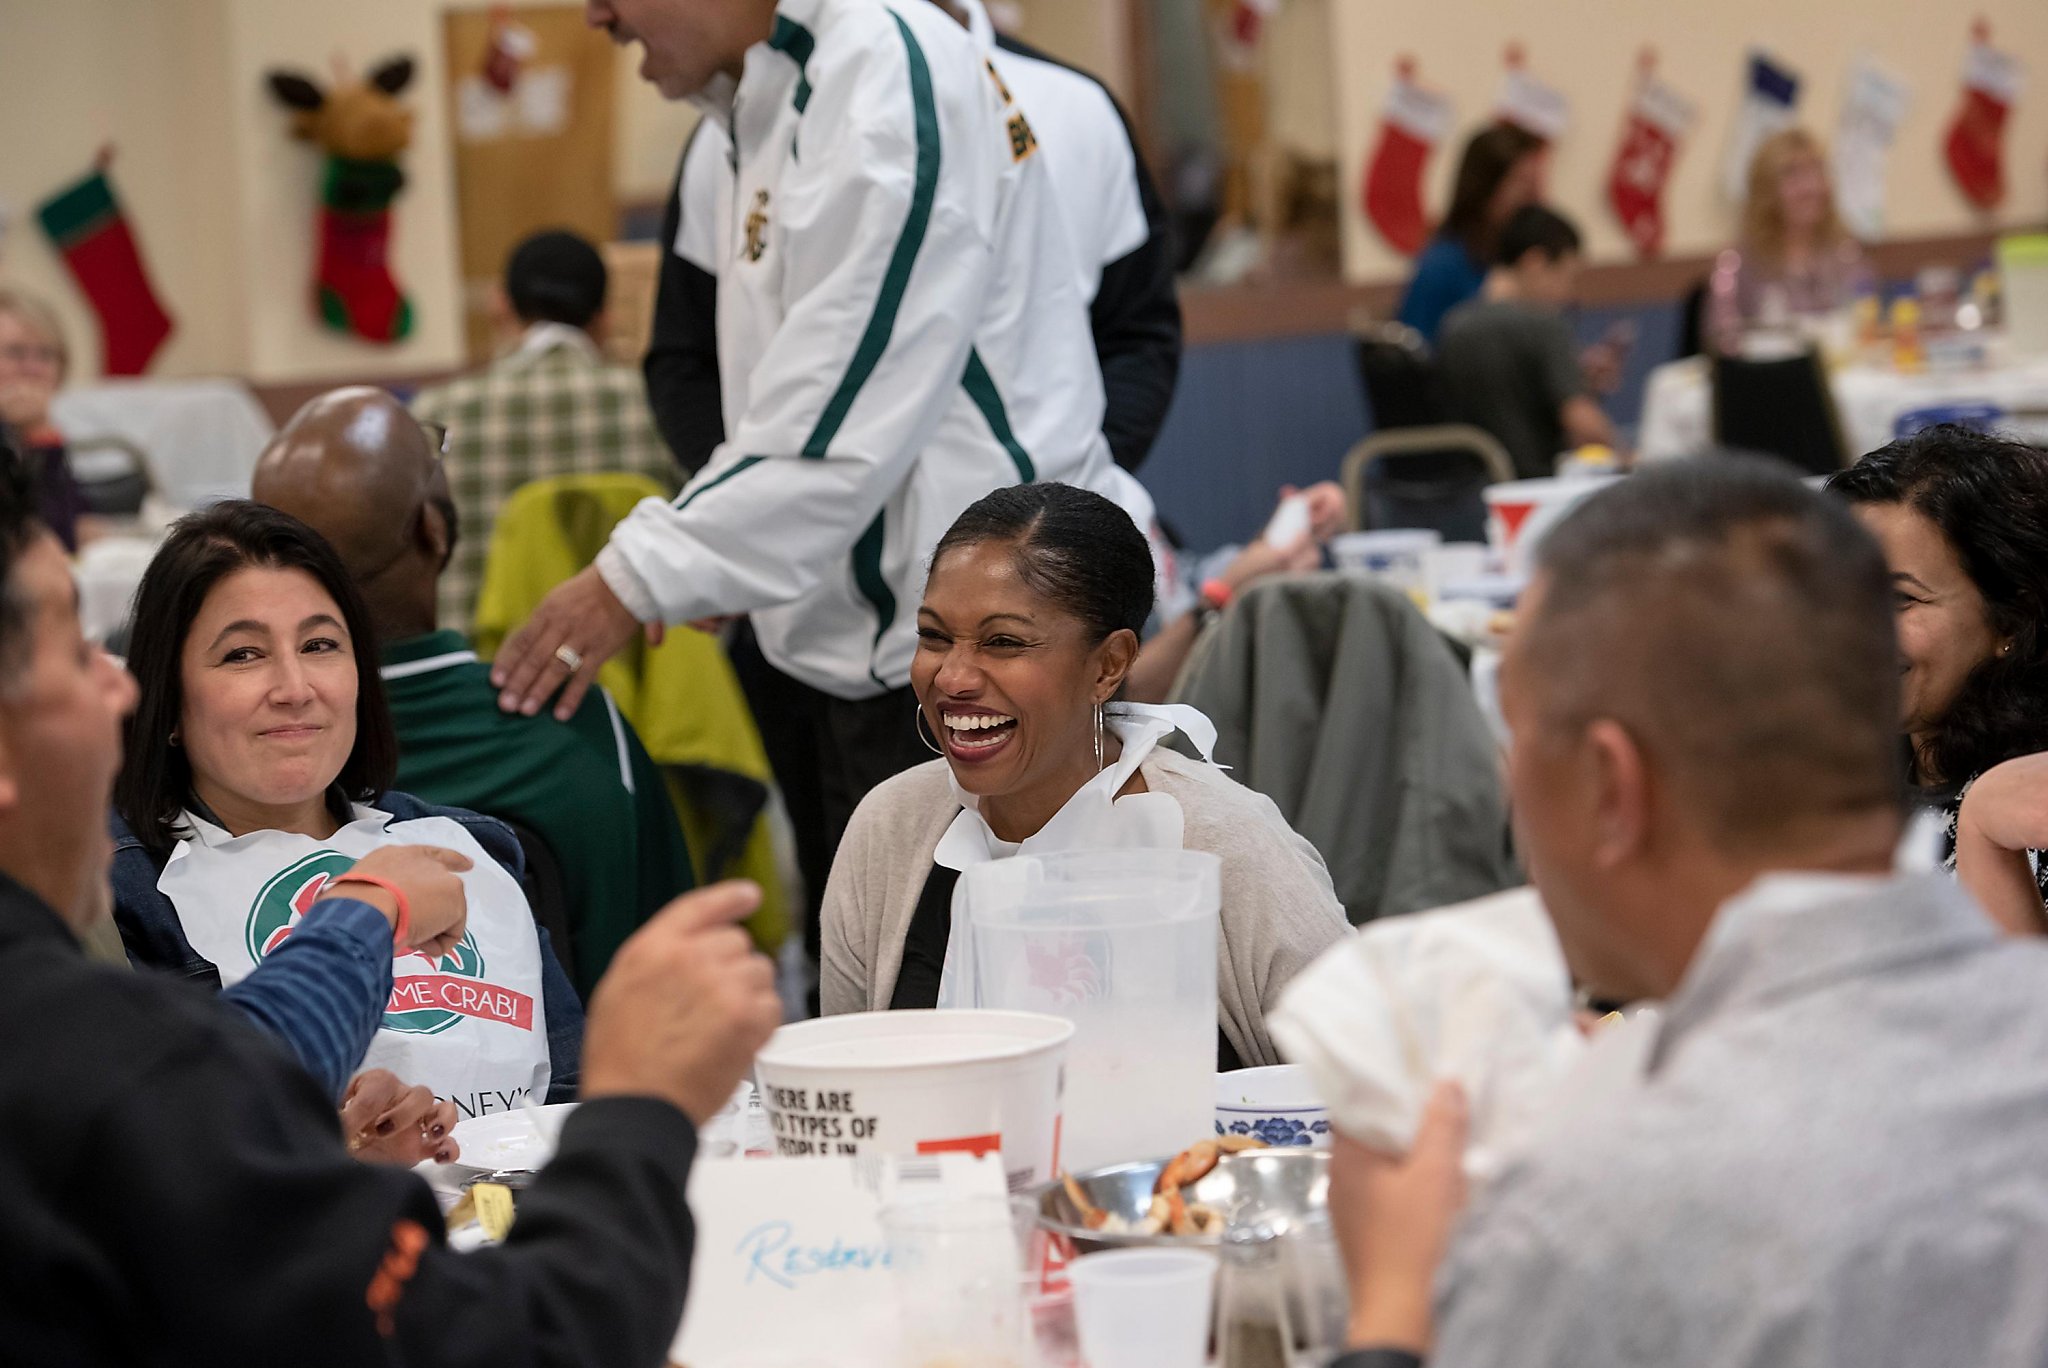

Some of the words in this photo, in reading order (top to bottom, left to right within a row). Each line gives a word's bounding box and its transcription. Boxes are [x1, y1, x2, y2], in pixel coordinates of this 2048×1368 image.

[440, 982, 517, 1020] CRAB!
[816, 1091, 854, 1113] ARE
[787, 1114, 843, 1138] TYPES
[850, 1118, 878, 1139] OF
